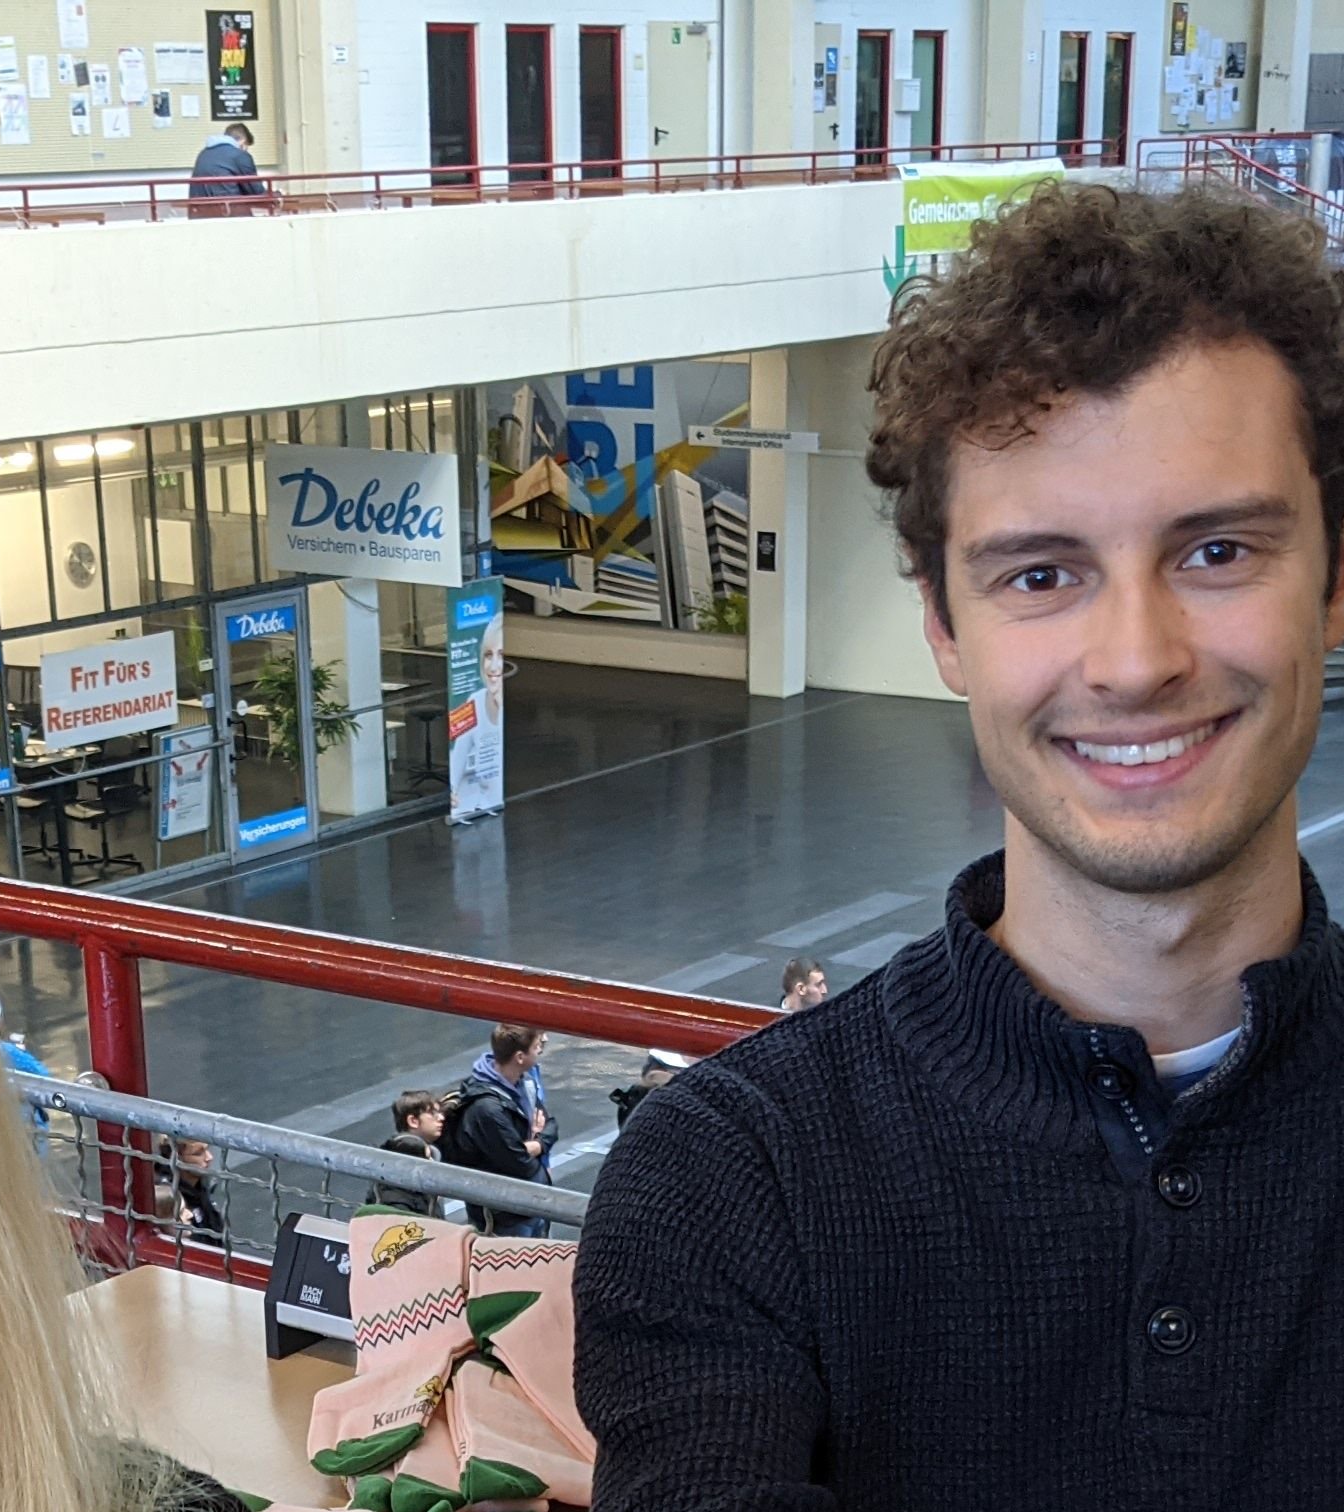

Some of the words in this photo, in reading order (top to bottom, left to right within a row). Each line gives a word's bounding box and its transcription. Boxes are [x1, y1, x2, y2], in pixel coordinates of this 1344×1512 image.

[909, 195, 981, 225] Gemeinsam
[278, 467, 444, 541] Debeka
[369, 541, 441, 562] Bausparen
[236, 612, 285, 638] Debeka
[239, 816, 307, 843] Versicherungen
